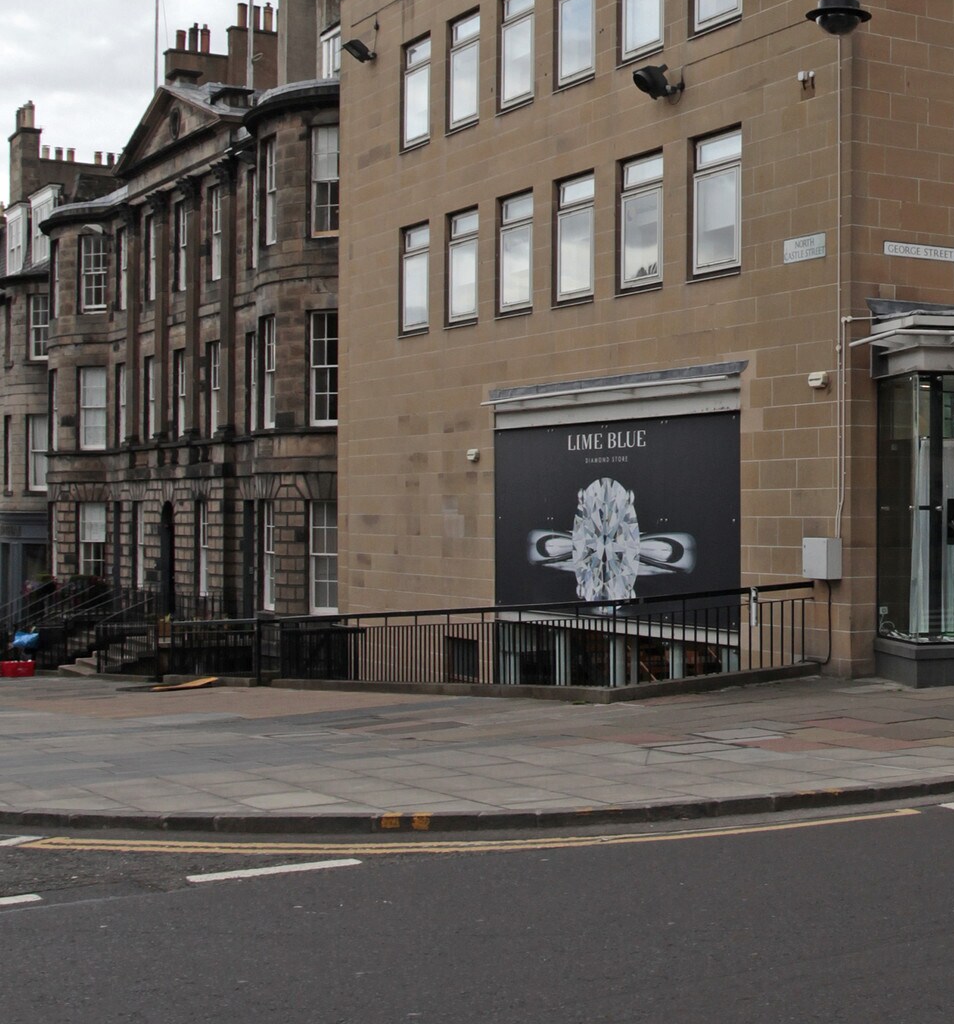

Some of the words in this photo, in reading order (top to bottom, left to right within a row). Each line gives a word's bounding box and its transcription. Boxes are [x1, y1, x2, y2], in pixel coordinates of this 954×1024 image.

[794, 237, 815, 249] NORTH
[784, 249, 804, 261] CASTLE
[805, 245, 825, 257] STREET
[887, 244, 921, 256] GEORGE
[923, 247, 954, 259] STREET
[567, 433, 603, 451] LIME
[607, 429, 647, 449] BLUE
